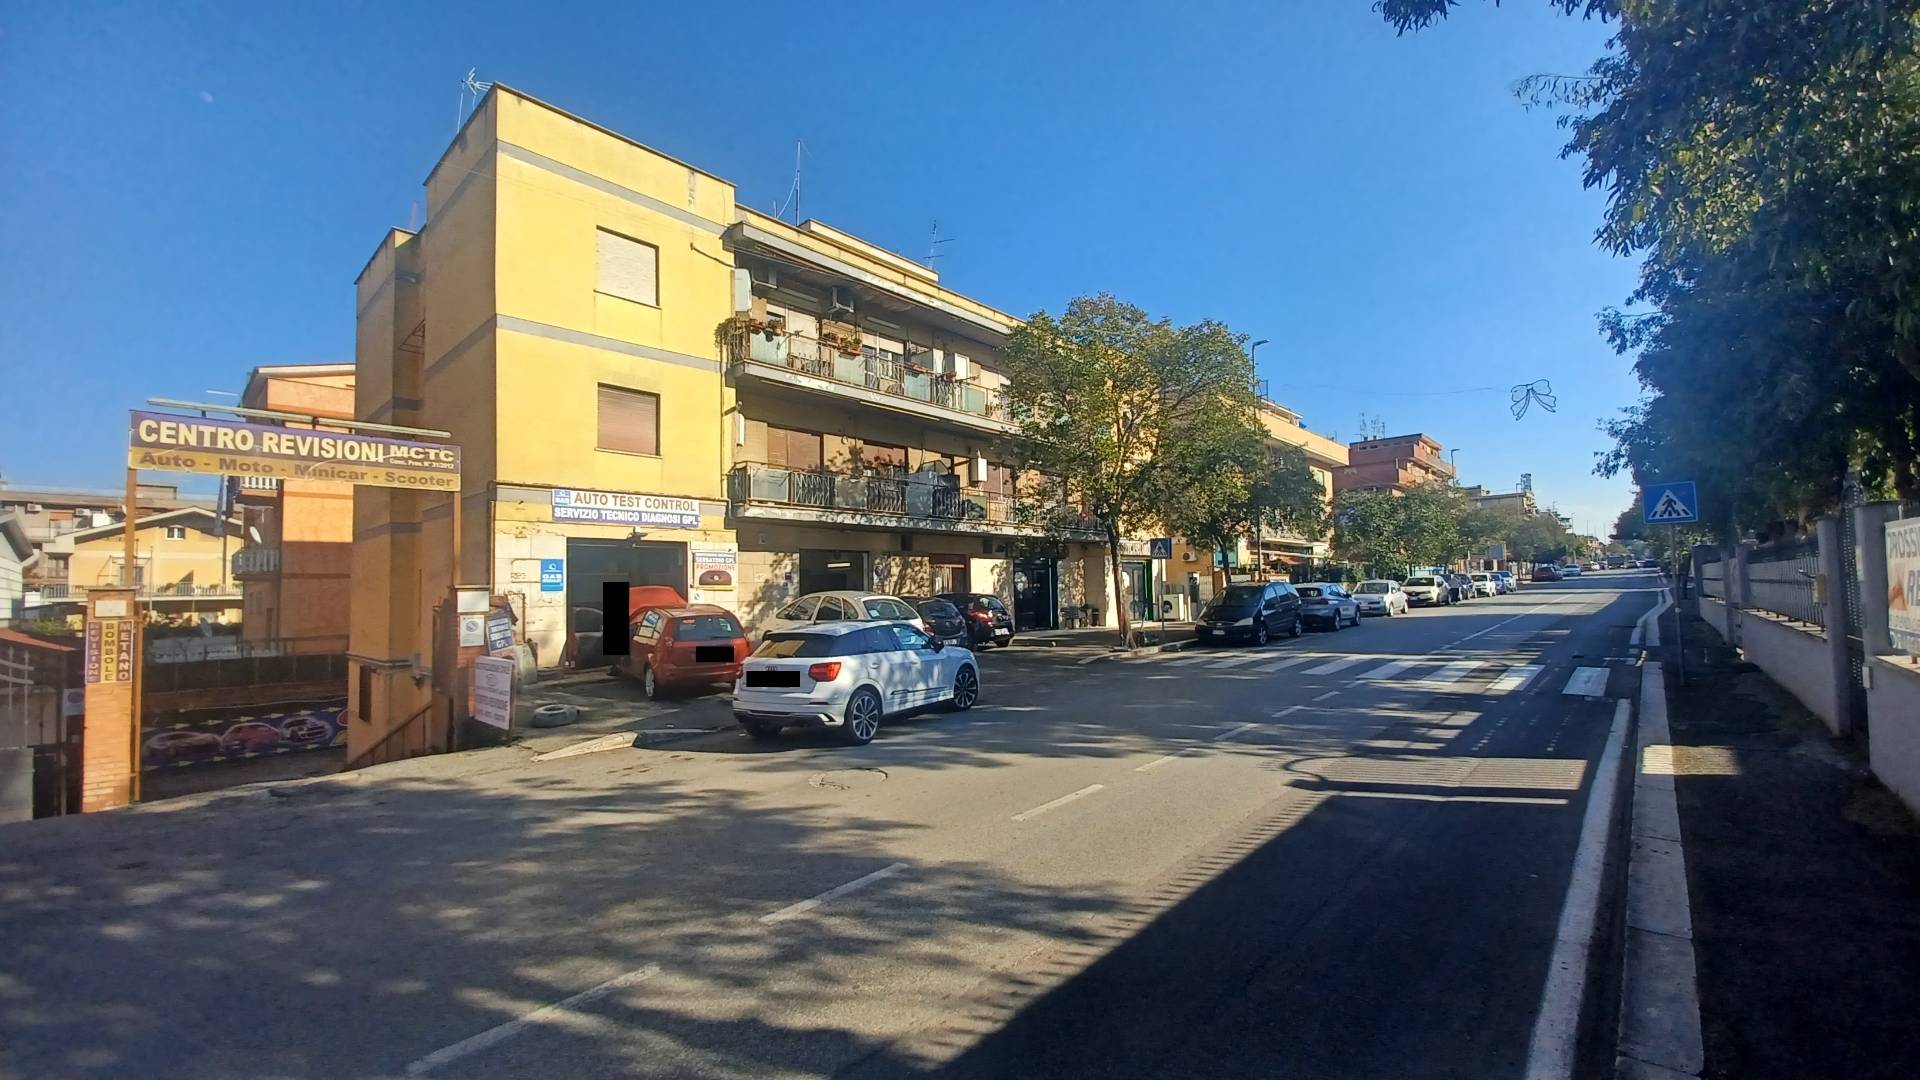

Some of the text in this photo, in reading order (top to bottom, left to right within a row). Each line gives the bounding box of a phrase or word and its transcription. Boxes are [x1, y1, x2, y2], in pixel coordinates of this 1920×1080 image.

[139, 419, 384, 463] CENTRO REVISIONI
[389, 444, 454, 462] MCTC
[140, 452, 196, 469] Auto
[219, 457, 273, 475] Moto
[295, 464, 368, 481] Minicar
[385, 471, 454, 487] Scooter
[574, 492, 608, 506] AUTO
[612, 495, 641, 508] TEST
[645, 497, 696, 512] CONTROL
[554, 507, 698, 525] SERVIZIO TECNICO DIAGNOSI GPL
[696, 563, 736, 571] PROMOZIONE
[104, 622, 116, 681] BOMBOLE
[118, 622, 131, 680] METANO
